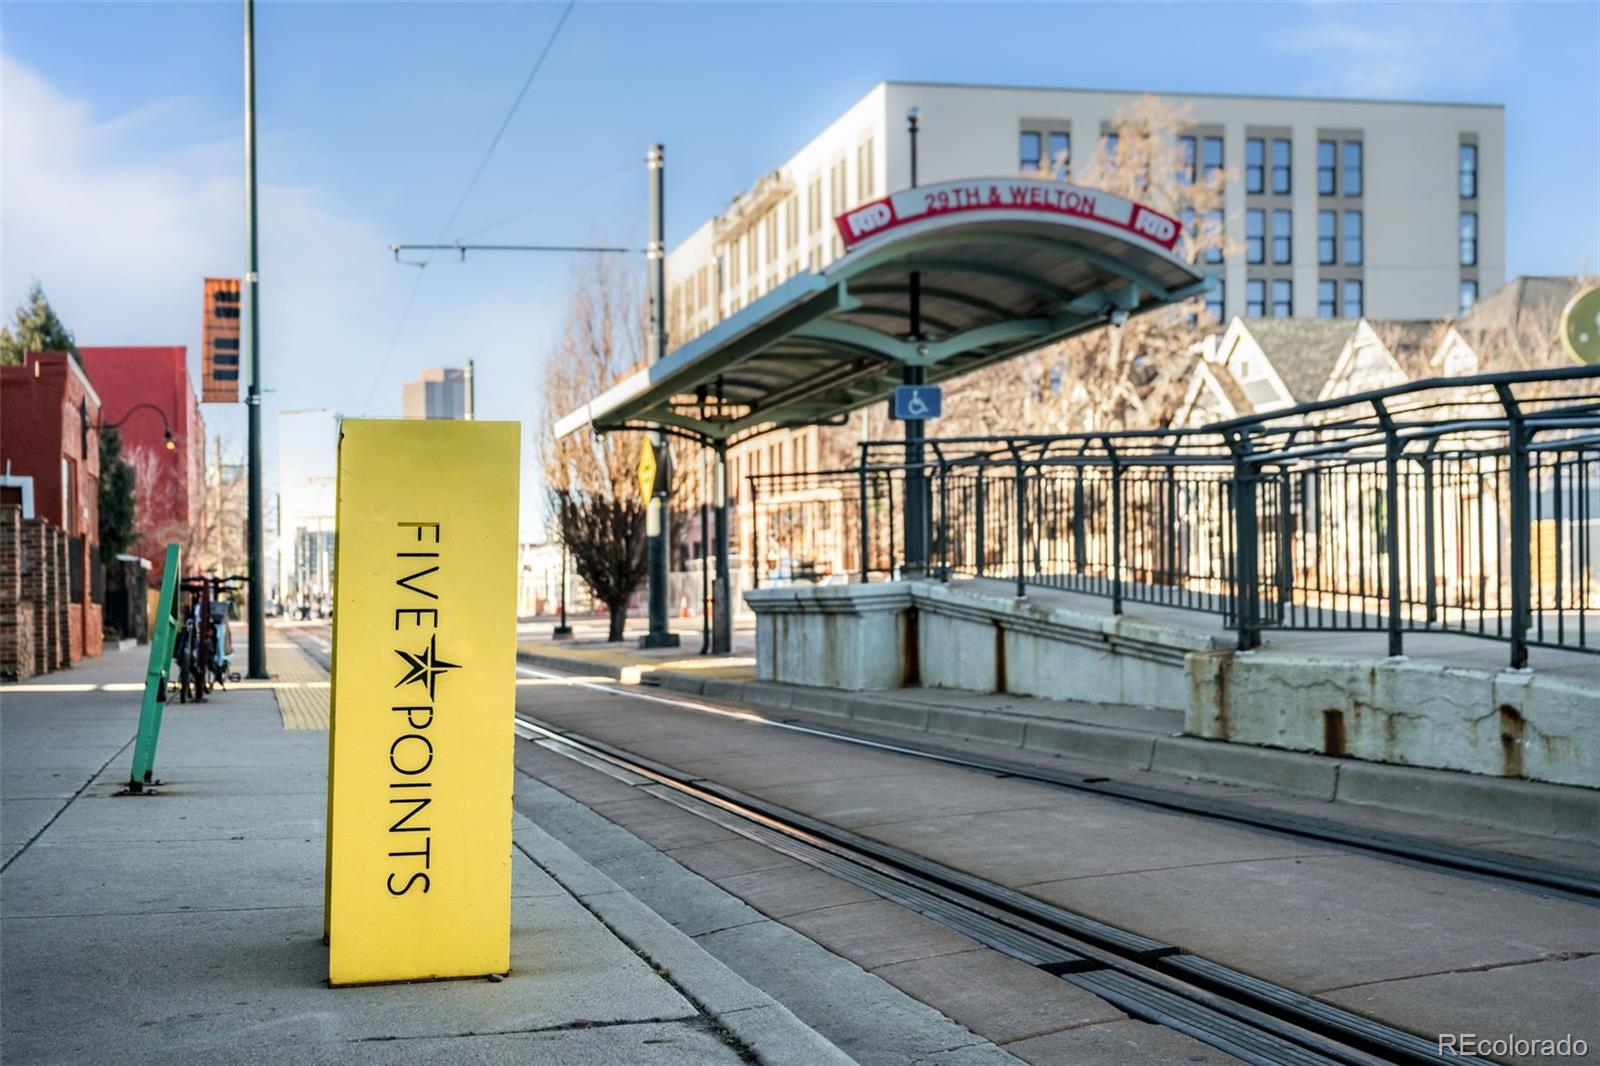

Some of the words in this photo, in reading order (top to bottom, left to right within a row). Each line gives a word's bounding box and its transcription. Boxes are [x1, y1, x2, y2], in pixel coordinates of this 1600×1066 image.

[925, 187, 980, 213] 29TH
[989, 185, 1001, 205] &
[1009, 185, 1097, 214] WELTON
[847, 203, 891, 237] RTD
[1135, 209, 1176, 241] RTD
[394, 522, 440, 630] FIVE
[387, 706, 433, 896] POINTS
